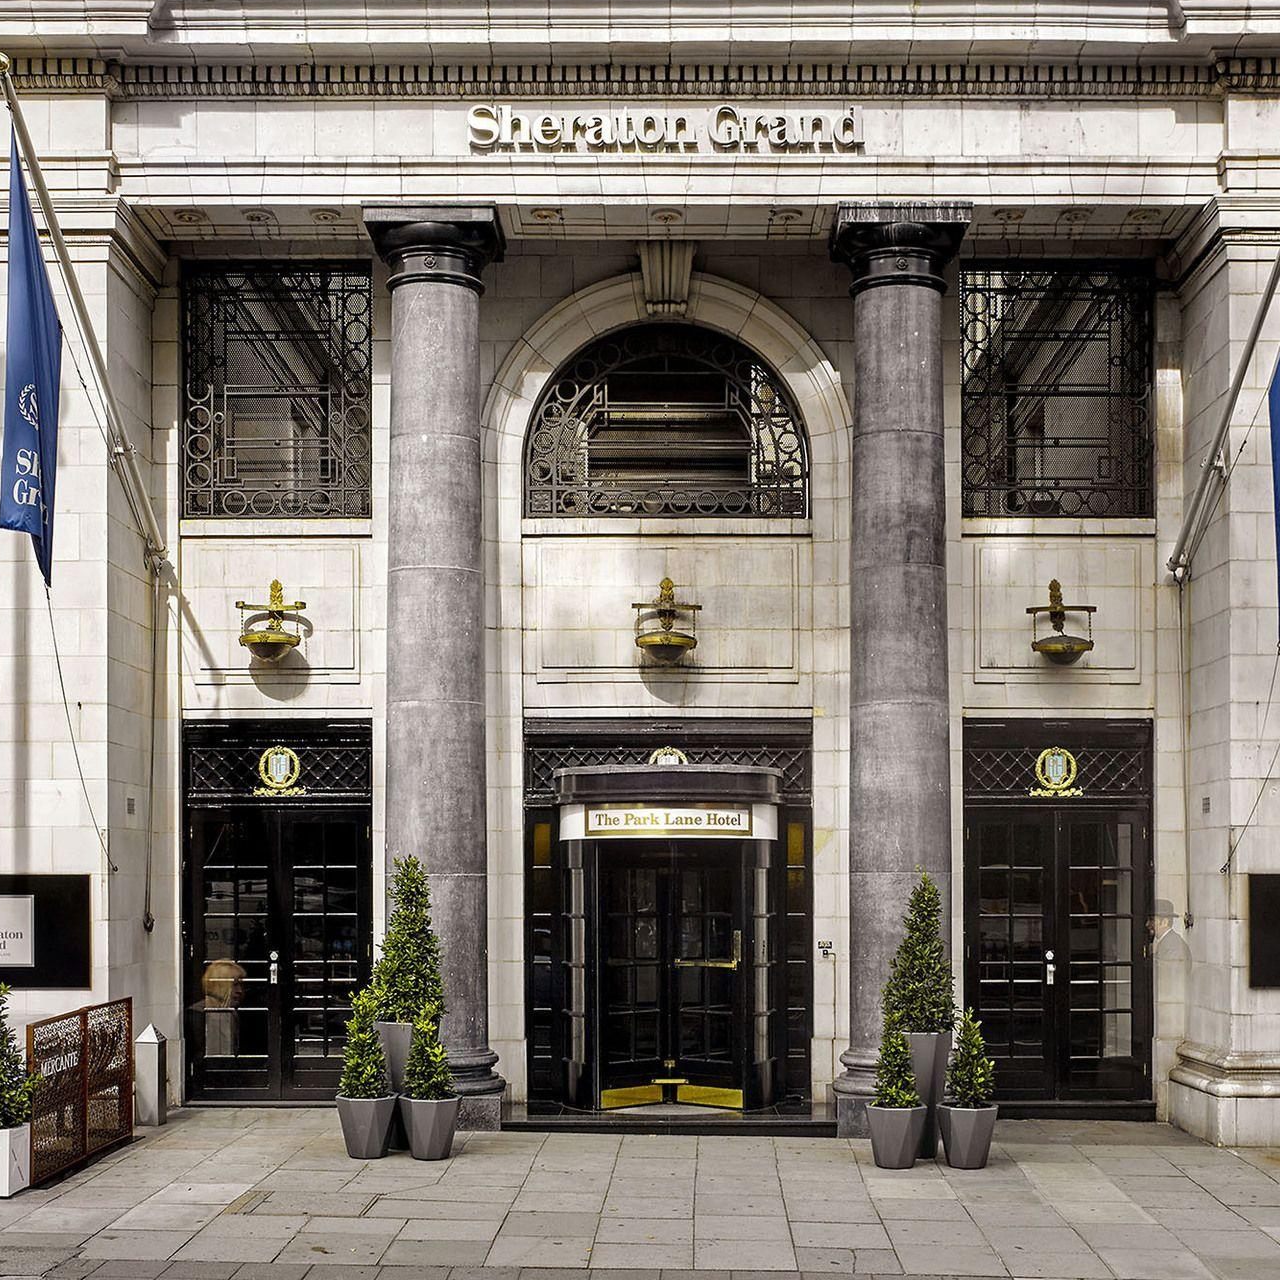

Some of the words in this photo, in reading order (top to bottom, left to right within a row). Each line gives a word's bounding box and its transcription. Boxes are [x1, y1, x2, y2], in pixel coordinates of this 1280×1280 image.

[467, 104, 697, 148] Sheraton
[707, 104, 866, 148] Grand
[595, 813, 620, 826] The
[624, 812, 660, 826] Park
[664, 812, 702, 826] Lane
[706, 813, 741, 826] Hotel
[41, 1051, 79, 1077] MERCANTE
